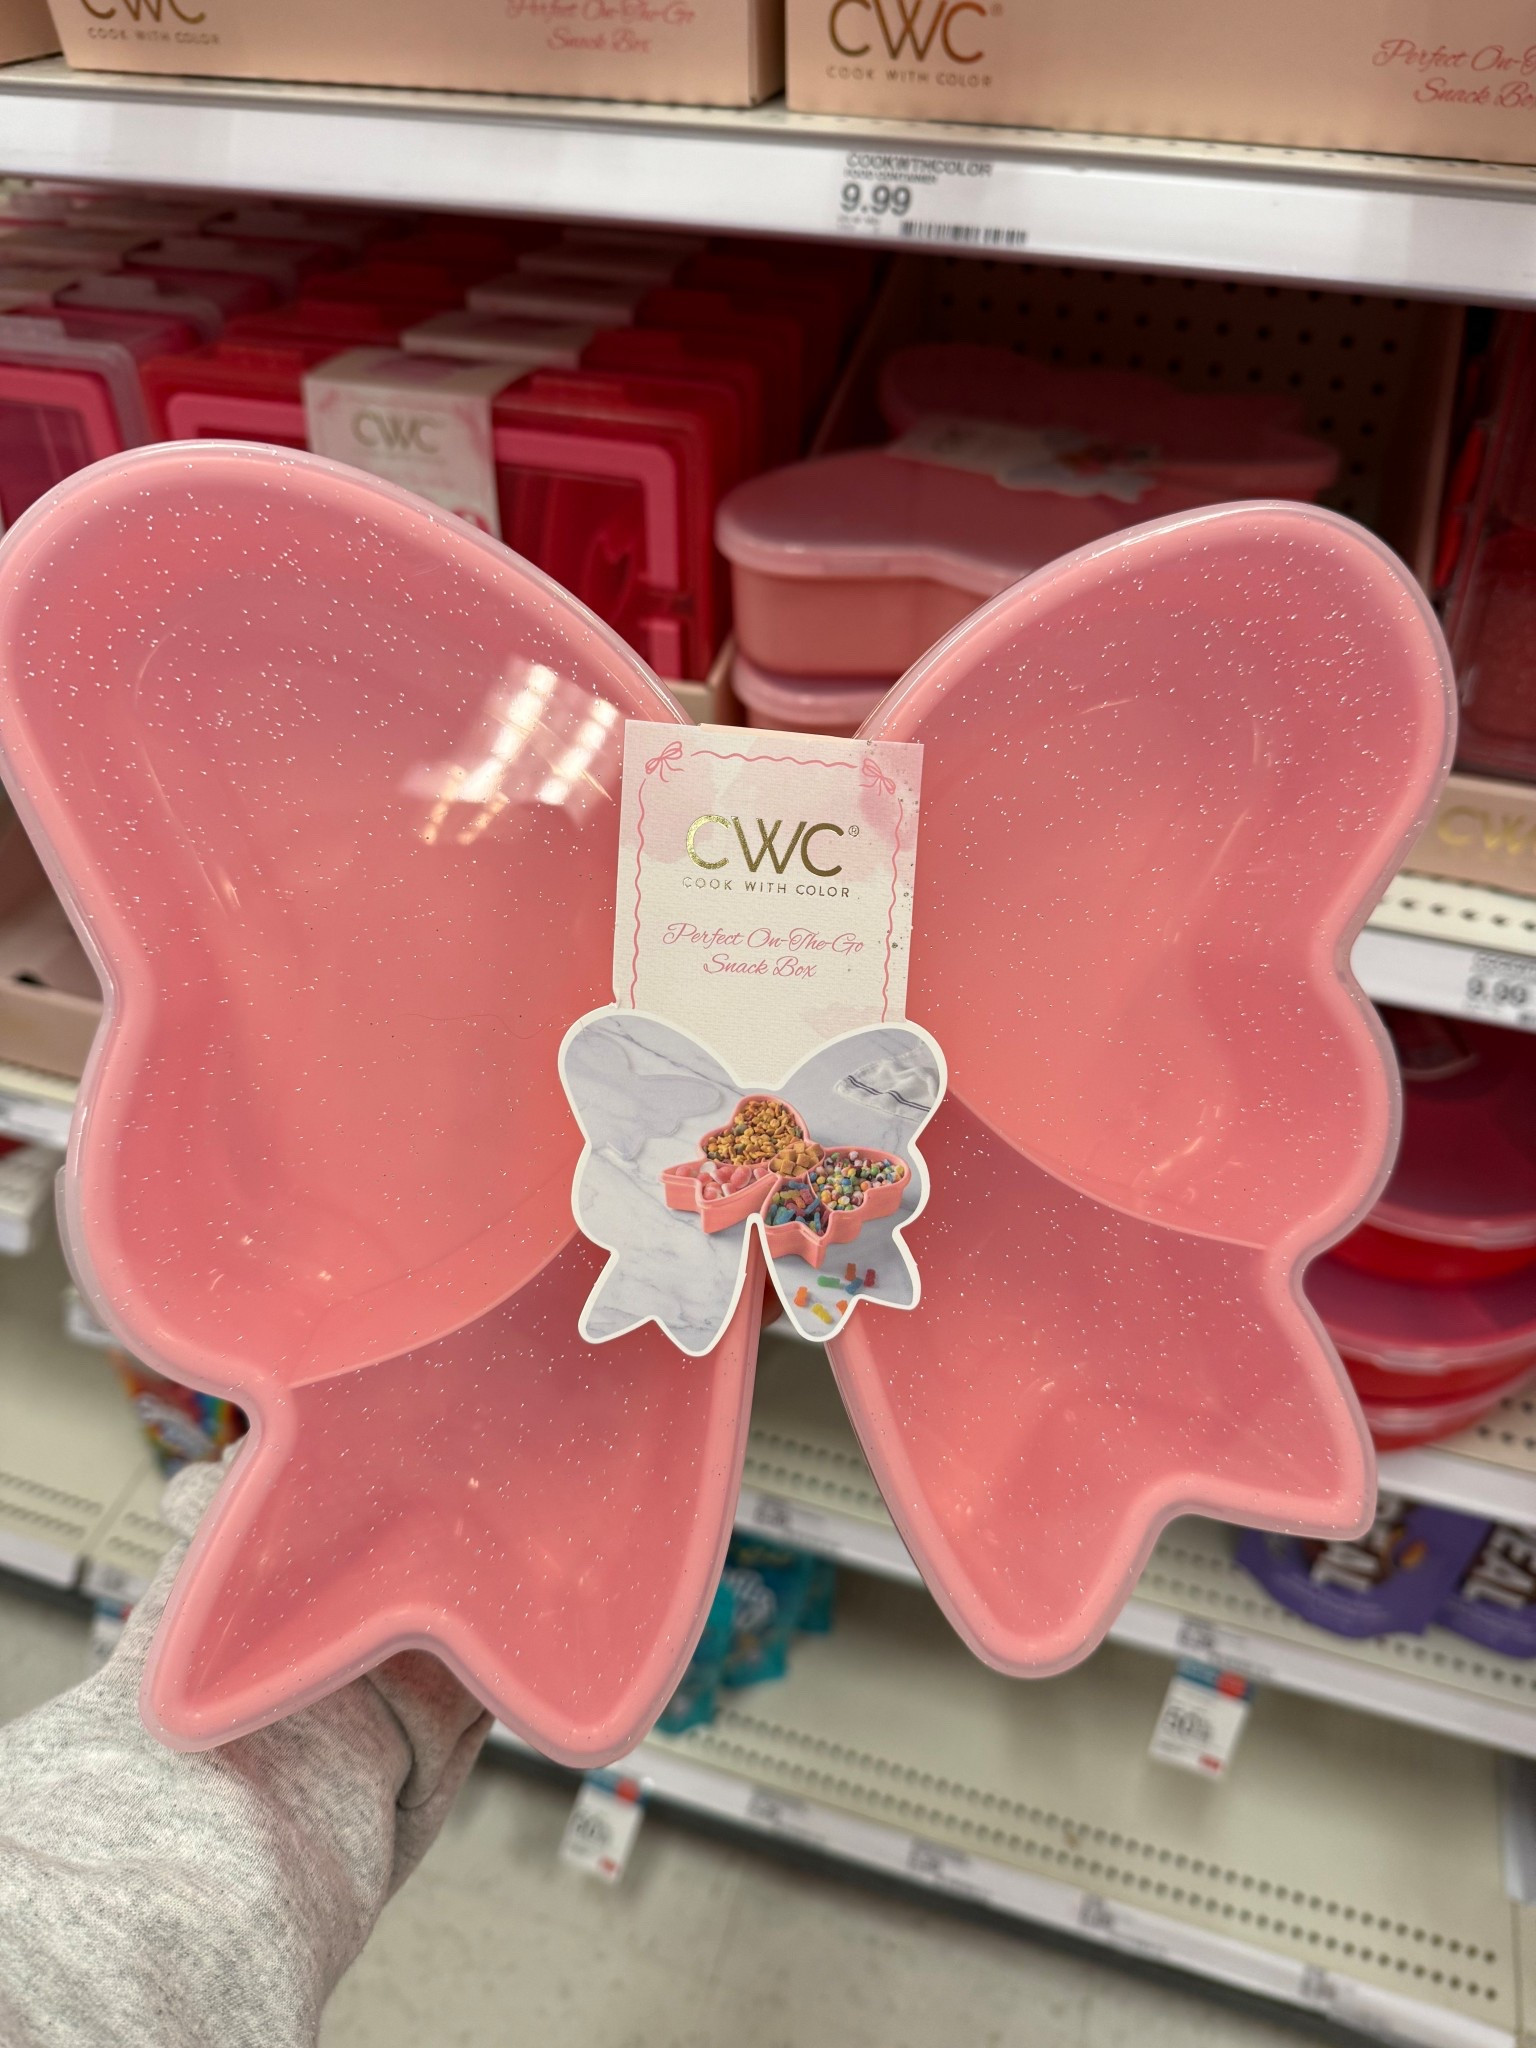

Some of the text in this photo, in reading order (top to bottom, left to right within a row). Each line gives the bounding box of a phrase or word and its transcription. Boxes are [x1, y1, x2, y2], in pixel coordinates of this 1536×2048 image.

[1372, 39, 1468, 72] Perfect
[825, 65, 993, 88] COOK WITH COLOR
[1413, 77, 1536, 108] Snack Bo
[840, 182, 912, 216] 9.99
[351, 410, 447, 455] CWC
[1437, 805, 1536, 857] CW
[682, 877, 850, 898] COOK WITH COLOR
[663, 922, 865, 956] Perfect On-The-Go
[703, 953, 818, 980] Snack Box
